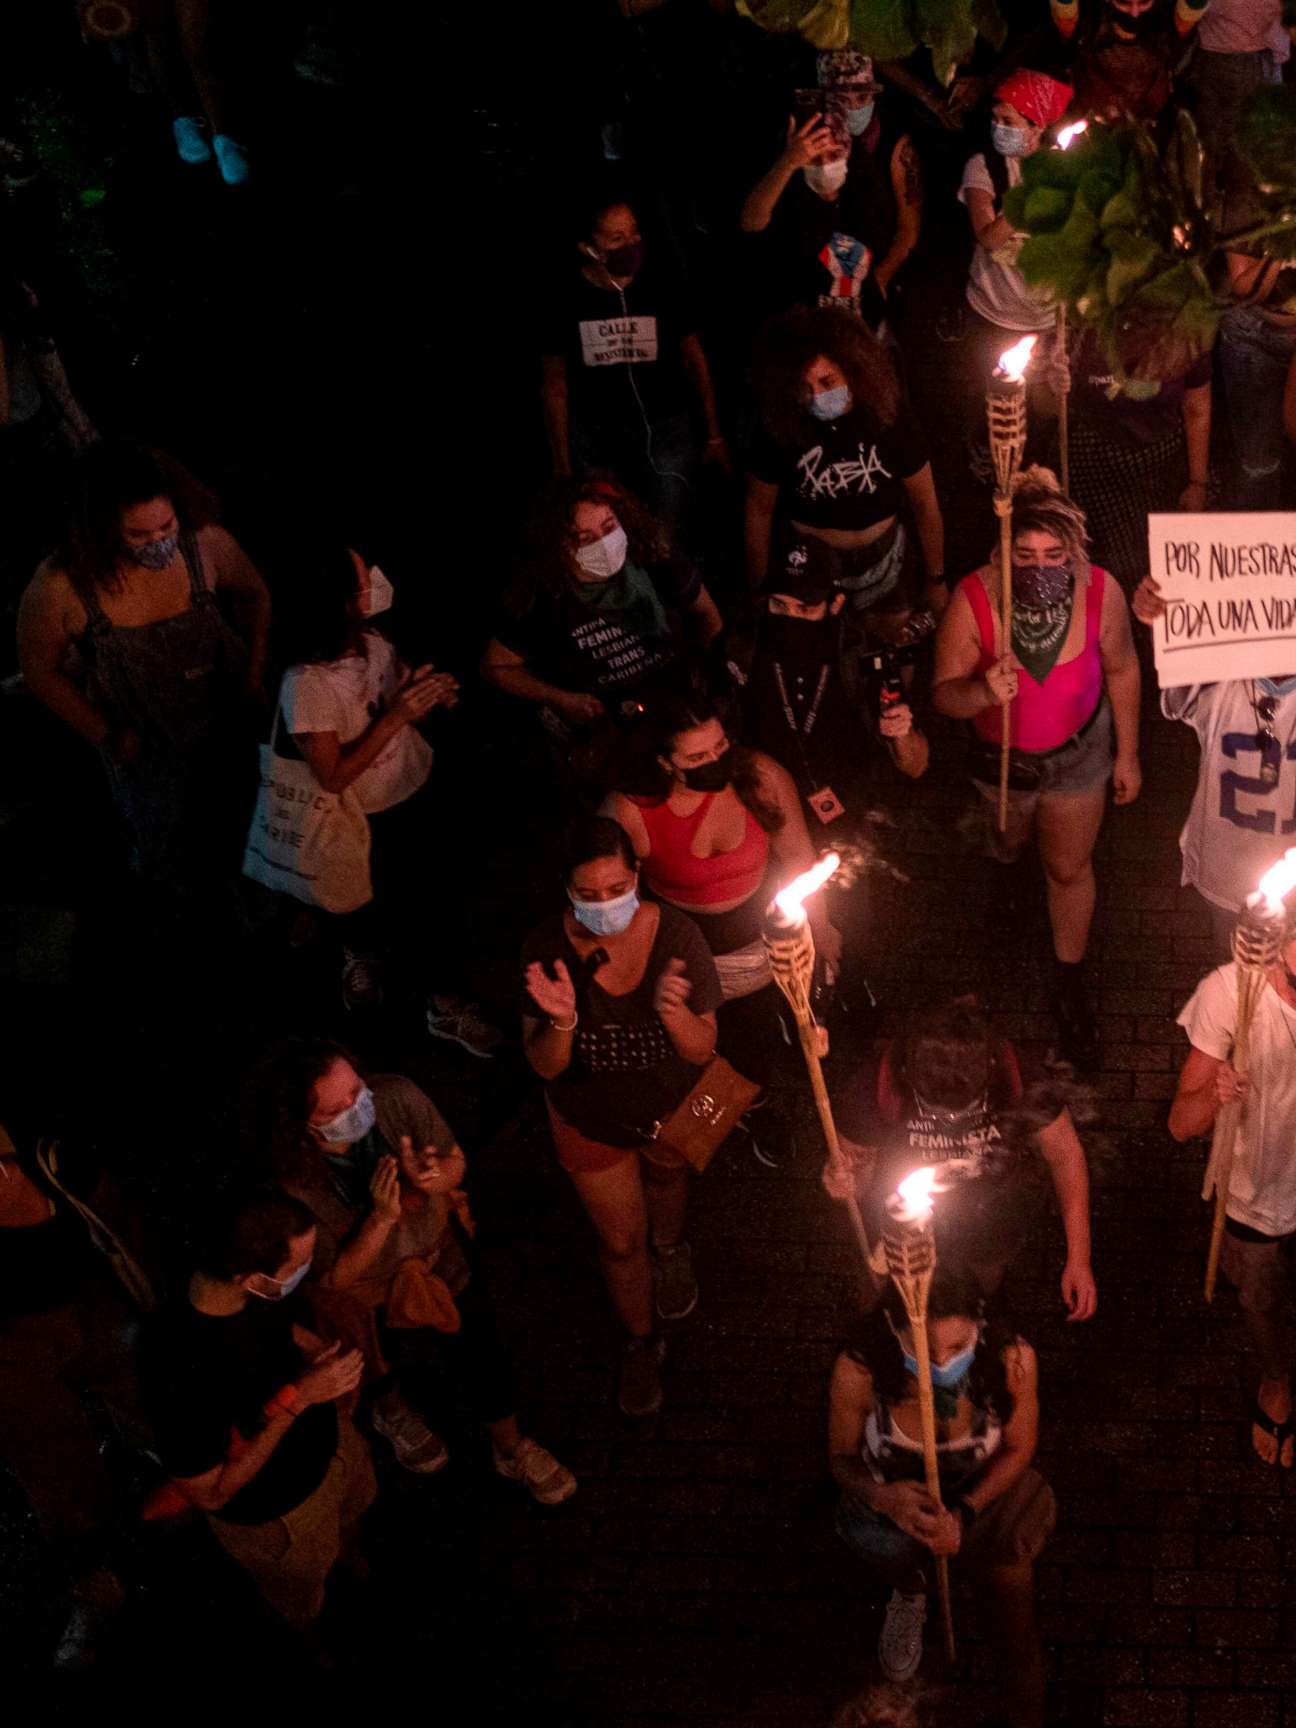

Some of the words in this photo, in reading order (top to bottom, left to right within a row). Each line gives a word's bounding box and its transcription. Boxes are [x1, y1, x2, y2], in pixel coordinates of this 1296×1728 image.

[599, 321, 639, 337] CALLE
[1164, 541, 1200, 579] POR
[1163, 599, 1216, 644] TODA
[1218, 599, 1259, 634] UNA
